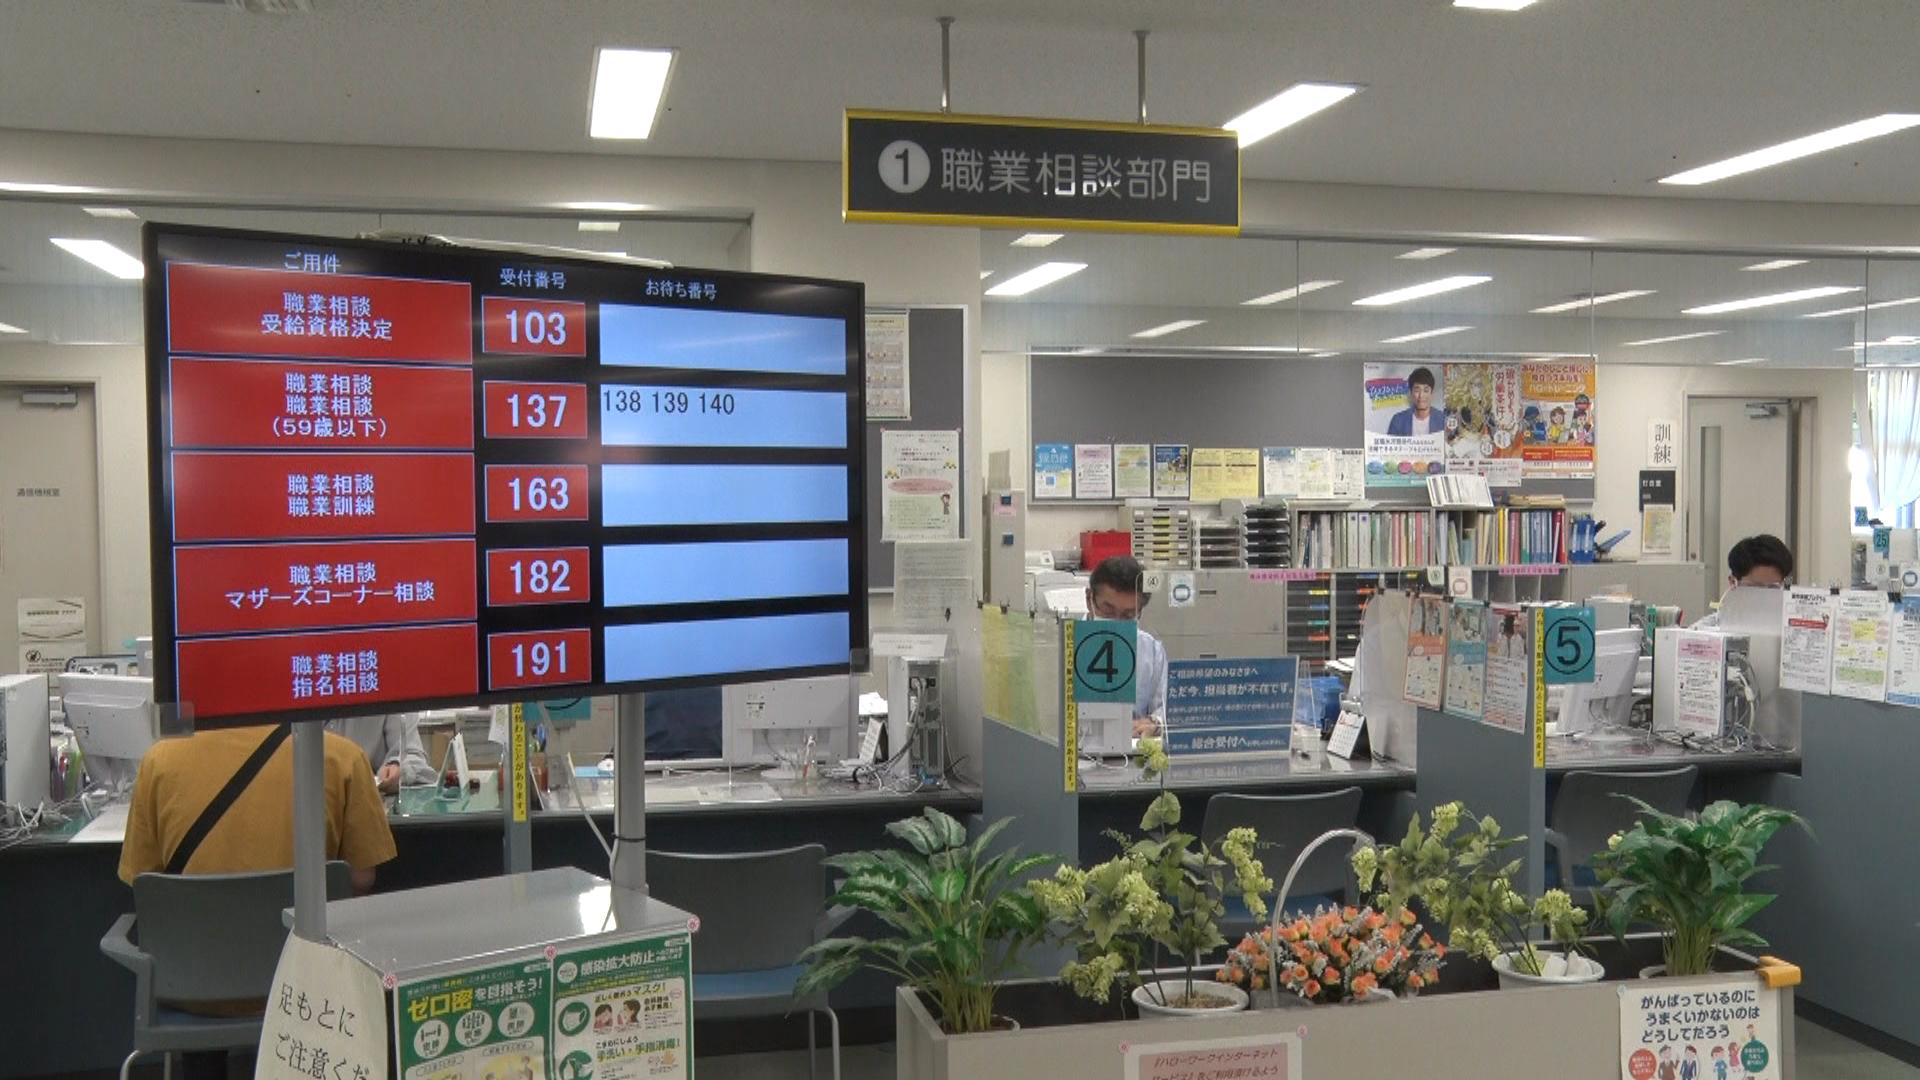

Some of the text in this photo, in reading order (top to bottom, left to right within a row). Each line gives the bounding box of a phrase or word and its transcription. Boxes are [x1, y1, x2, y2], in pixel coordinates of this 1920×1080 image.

[939, 147, 1211, 203] 職業相談部門
[284, 251, 341, 273] ご用件
[499, 268, 567, 290] 受付番号
[645, 280, 717, 300] お待ち番号
[283, 292, 372, 317] 職業相談
[261, 314, 393, 341] 受給資格決定
[505, 310, 567, 346] 103
[285, 373, 373, 396] 職業相談
[285, 395, 374, 417] 職業相談
[507, 395, 568, 428] 137
[602, 390, 735, 415] 138 139 140
[272, 417, 388, 438] (59歳以下)
[1653, 423, 1672, 464] 訓練
[287, 474, 375, 495] 職業相談
[508, 477, 569, 512] 163
[288, 495, 375, 517] 職業訓練
[1876, 534, 1888, 547] 25
[289, 562, 377, 586] 職業相談
[509, 559, 571, 595] 182
[224, 581, 435, 610] マザーズコーナー相談
[291, 650, 378, 674] 職業相談
[511, 640, 569, 677] 191
[292, 673, 379, 699] 指名相談
[279, 982, 355, 1037] 足もとに
[1641, 989, 1756, 1010] がんばっているのに
[1645, 1006, 1760, 1027] うまくいかないのは
[1641, 1025, 1730, 1044] どうしてだろう
